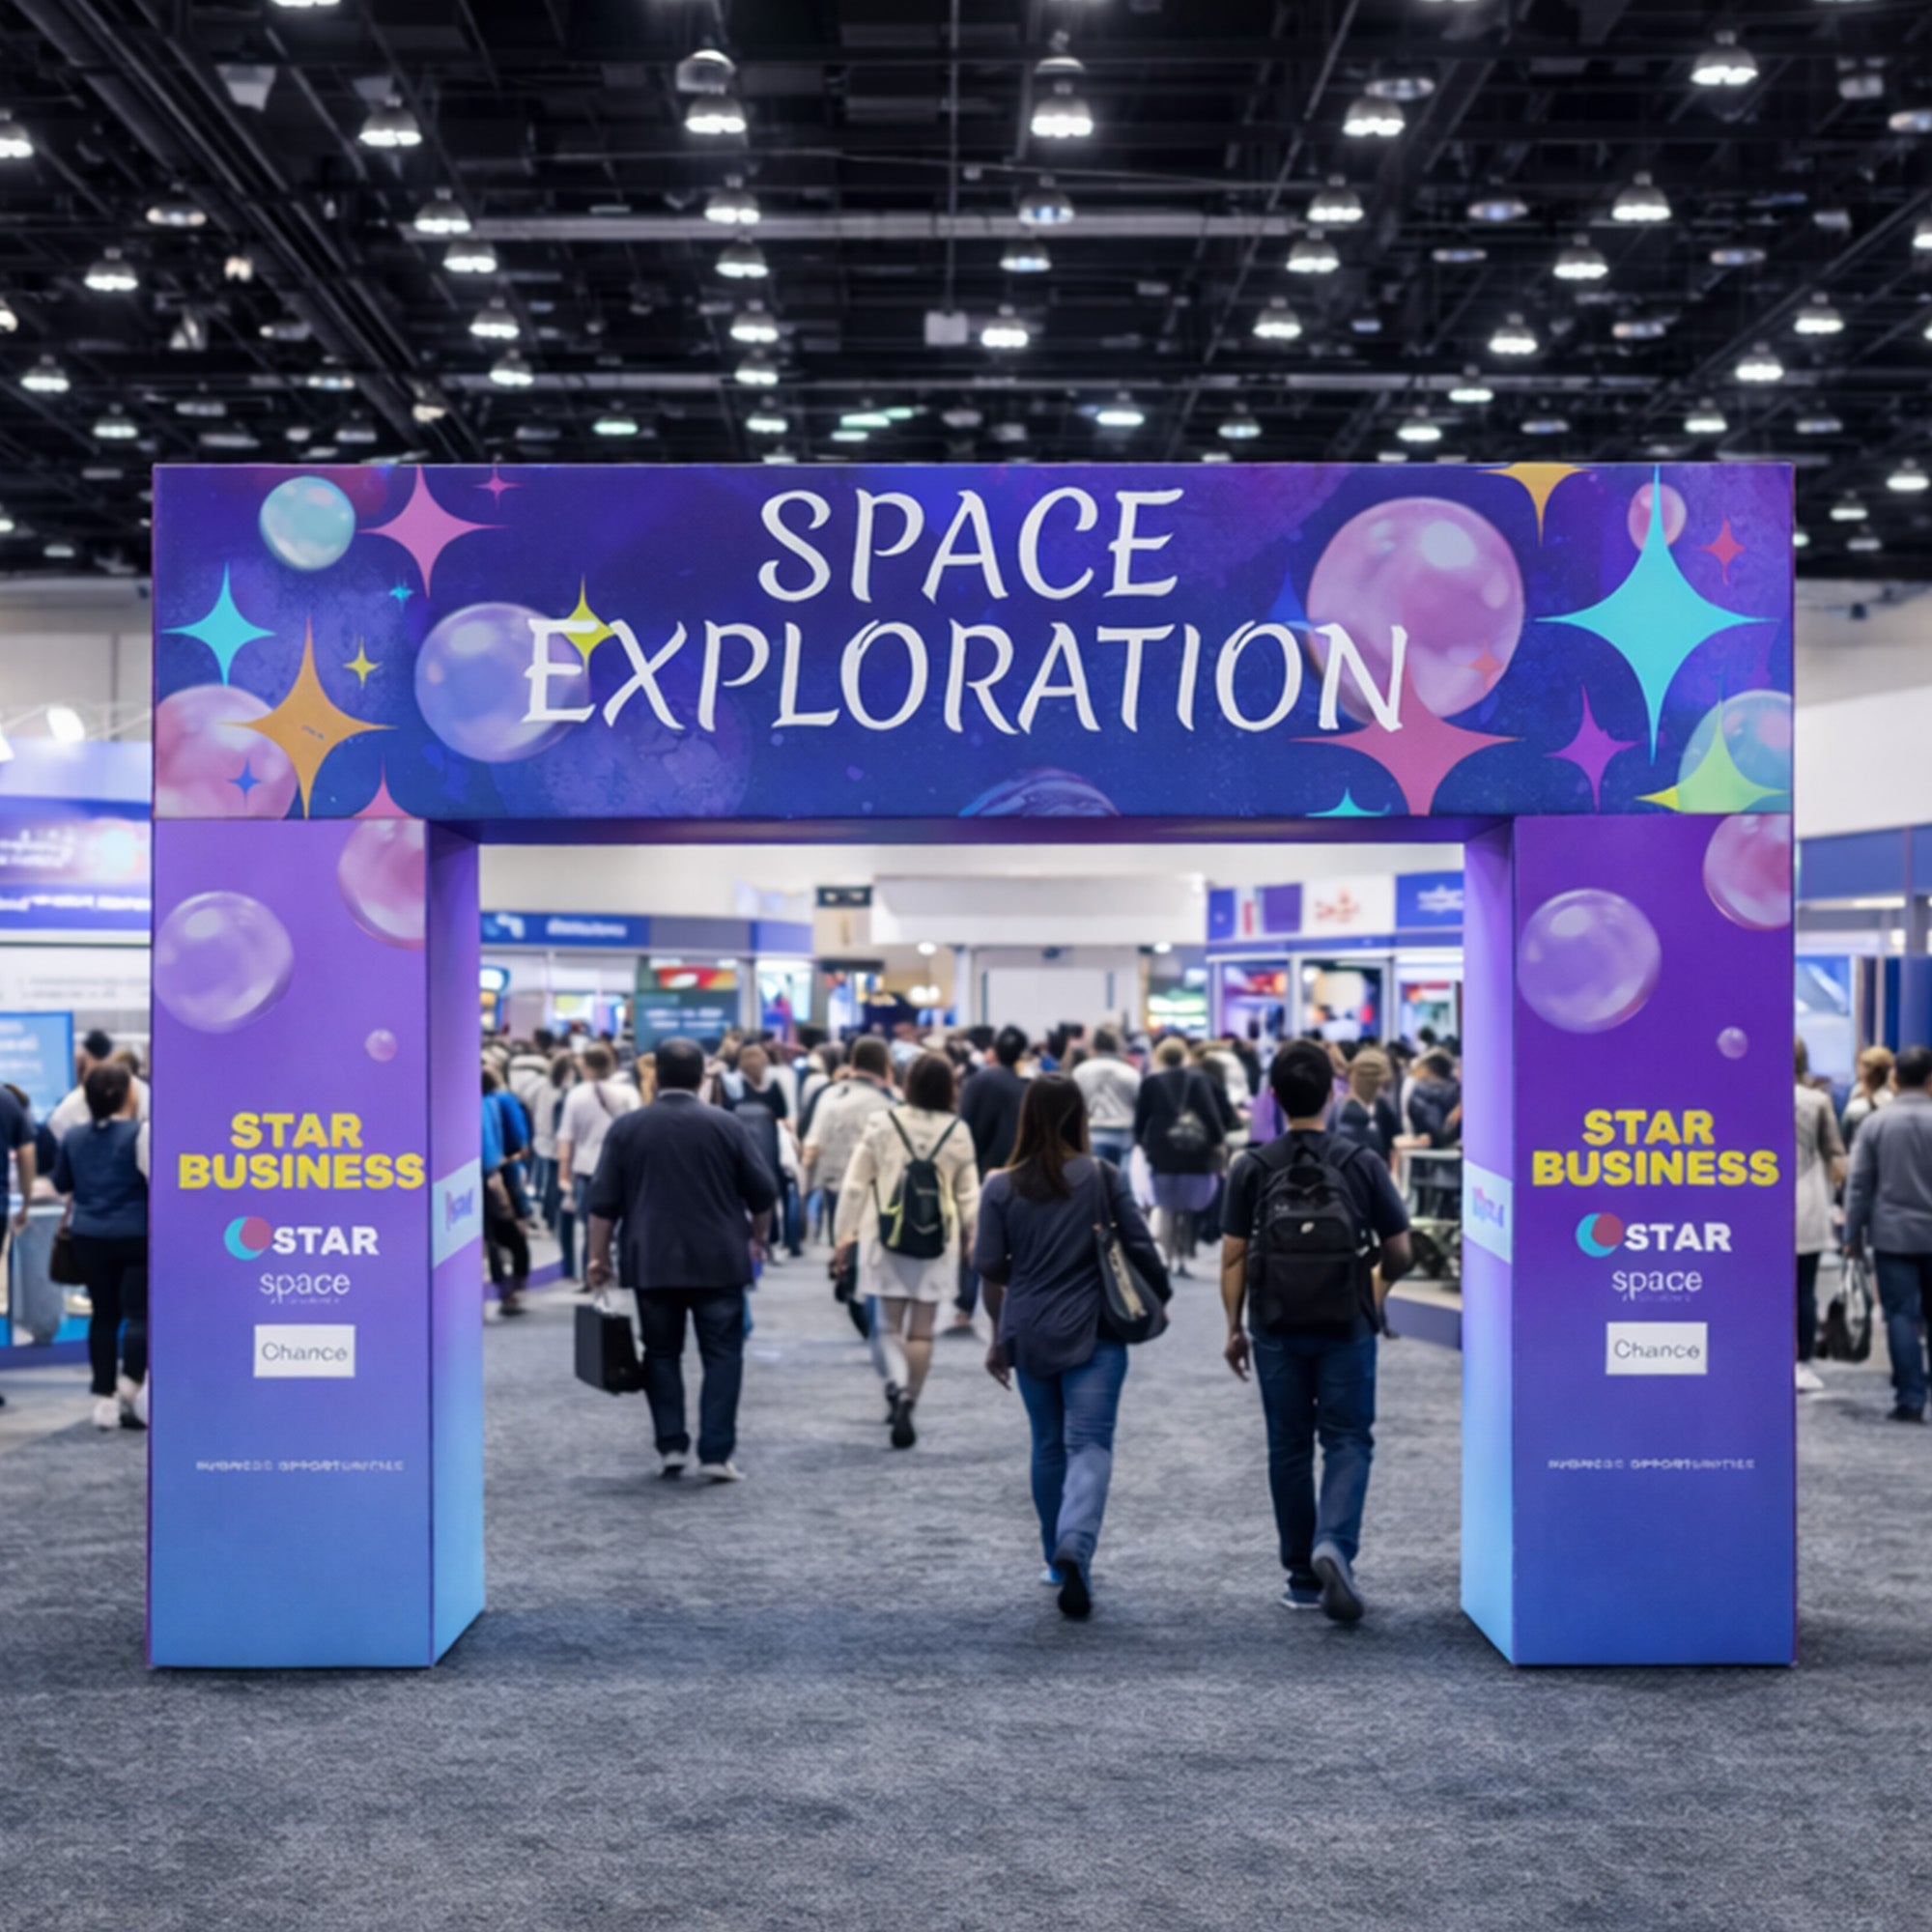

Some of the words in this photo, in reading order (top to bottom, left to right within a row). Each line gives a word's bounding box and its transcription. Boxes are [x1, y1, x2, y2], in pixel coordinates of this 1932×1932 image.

[757, 487, 1184, 601] SPACE
[522, 619, 1407, 733] EXPLORATION
[230, 1112, 363, 1149] STAR
[1581, 1109, 1716, 1147] STAR
[178, 1152, 426, 1190] BUSINESS
[1531, 1150, 1779, 1187] BUSINESS
[271, 1226, 380, 1256] STAR
[1624, 1222, 1732, 1252] STAR
[259, 1272, 352, 1304] space
[1611, 1270, 1703, 1301] space
[261, 1342, 349, 1362] Chance
[1613, 1338, 1701, 1360] Chance
